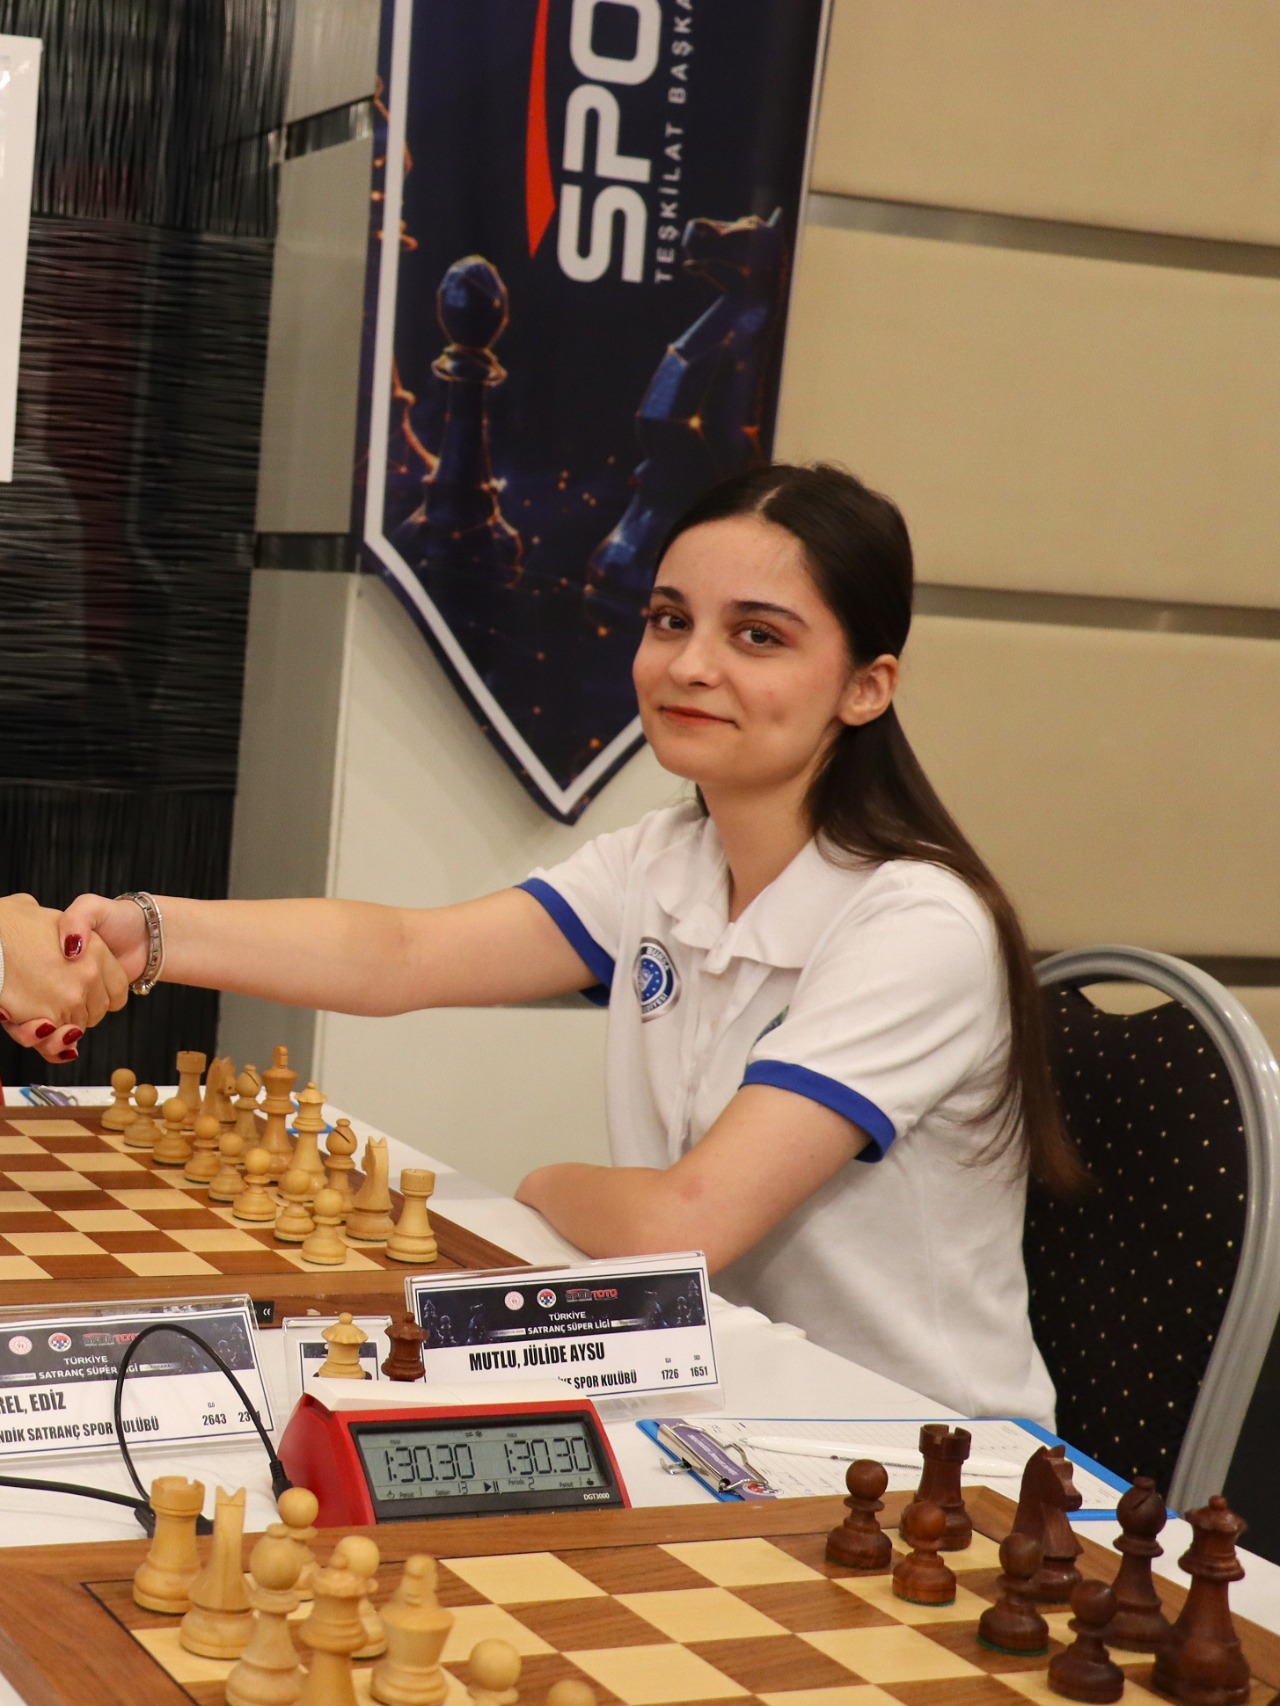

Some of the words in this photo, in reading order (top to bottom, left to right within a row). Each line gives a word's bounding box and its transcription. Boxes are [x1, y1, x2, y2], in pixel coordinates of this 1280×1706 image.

[655, 123, 686, 284] TEŞKİLAT
[527, 1324, 566, 1334] SATRANÇ
[566, 1320, 594, 1331] SÜPER
[595, 1318, 611, 1329] LİGİ
[548, 1311, 587, 1321] TÜRKİYE
[63, 1354, 108, 1366] TÜRKİYE
[469, 1349, 521, 1372] MUTLU,
[523, 1343, 568, 1366] JÜLİDE
[570, 1342, 605, 1362] AYSU
[38, 1369, 85, 1380] SATRANÇ
[86, 1364, 118, 1377] SÜPER
[574, 1376, 599, 1389] SPOR
[601, 1369, 637, 1386] KULÜBÜ
[661, 1368, 679, 1380] 1726
[690, 1365, 708, 1377] 1651
[29, 1388, 67, 1412] EDİZ
[27, 1423, 81, 1440] SATRANÇ
[82, 1421, 114, 1436] SPOR
[117, 1415, 159, 1434] ULÜBÜ
[202, 1413, 227, 1426] 2643
[385, 1443, 475, 1482] 1:30.30
[504, 1436, 593, 1475] 1:30.30
[458, 1482, 469, 1495] 13
[528, 1477, 536, 1490] 2
[583, 1492, 610, 1501] DGT3000
